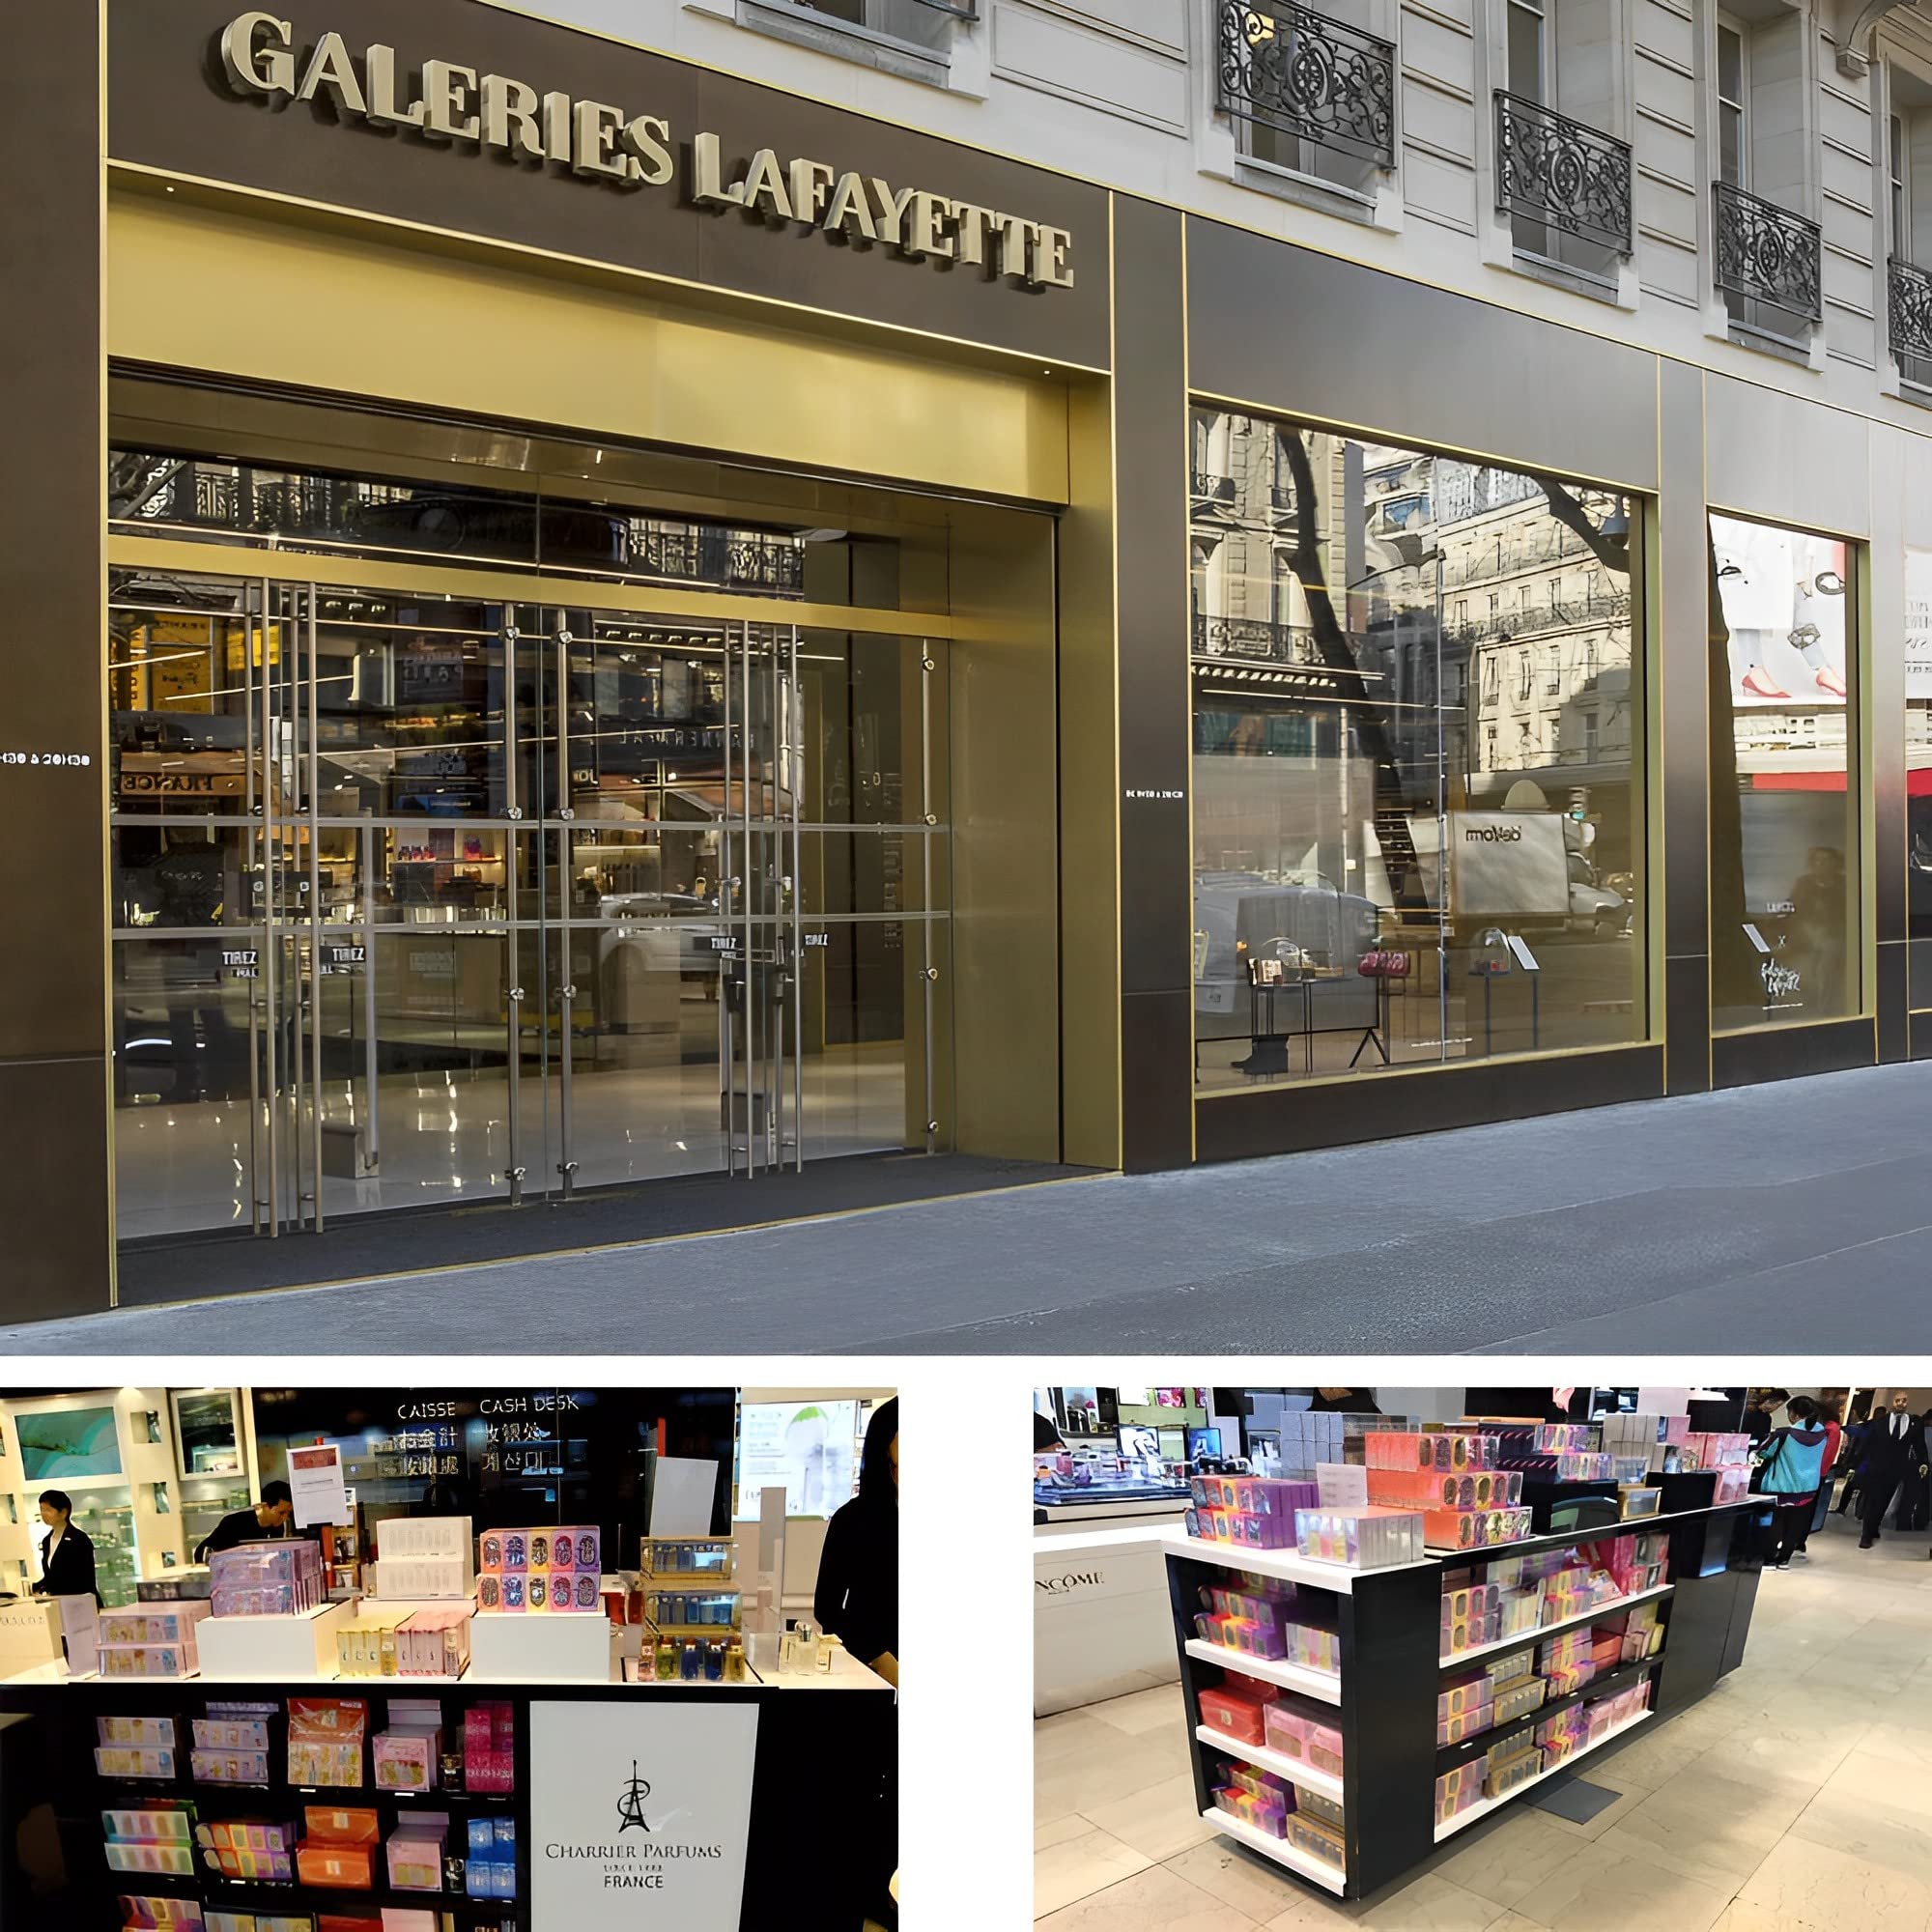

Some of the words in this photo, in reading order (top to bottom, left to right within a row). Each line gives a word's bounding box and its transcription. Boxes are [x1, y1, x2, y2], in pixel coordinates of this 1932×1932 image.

[221, 12, 674, 185] GALERIES
[694, 131, 1074, 288] LAFAYETTE
[397, 1402, 456, 1419] CAISSE
[480, 1397, 526, 1413] CASH
[604, 1875, 664, 1889] FRANCE
